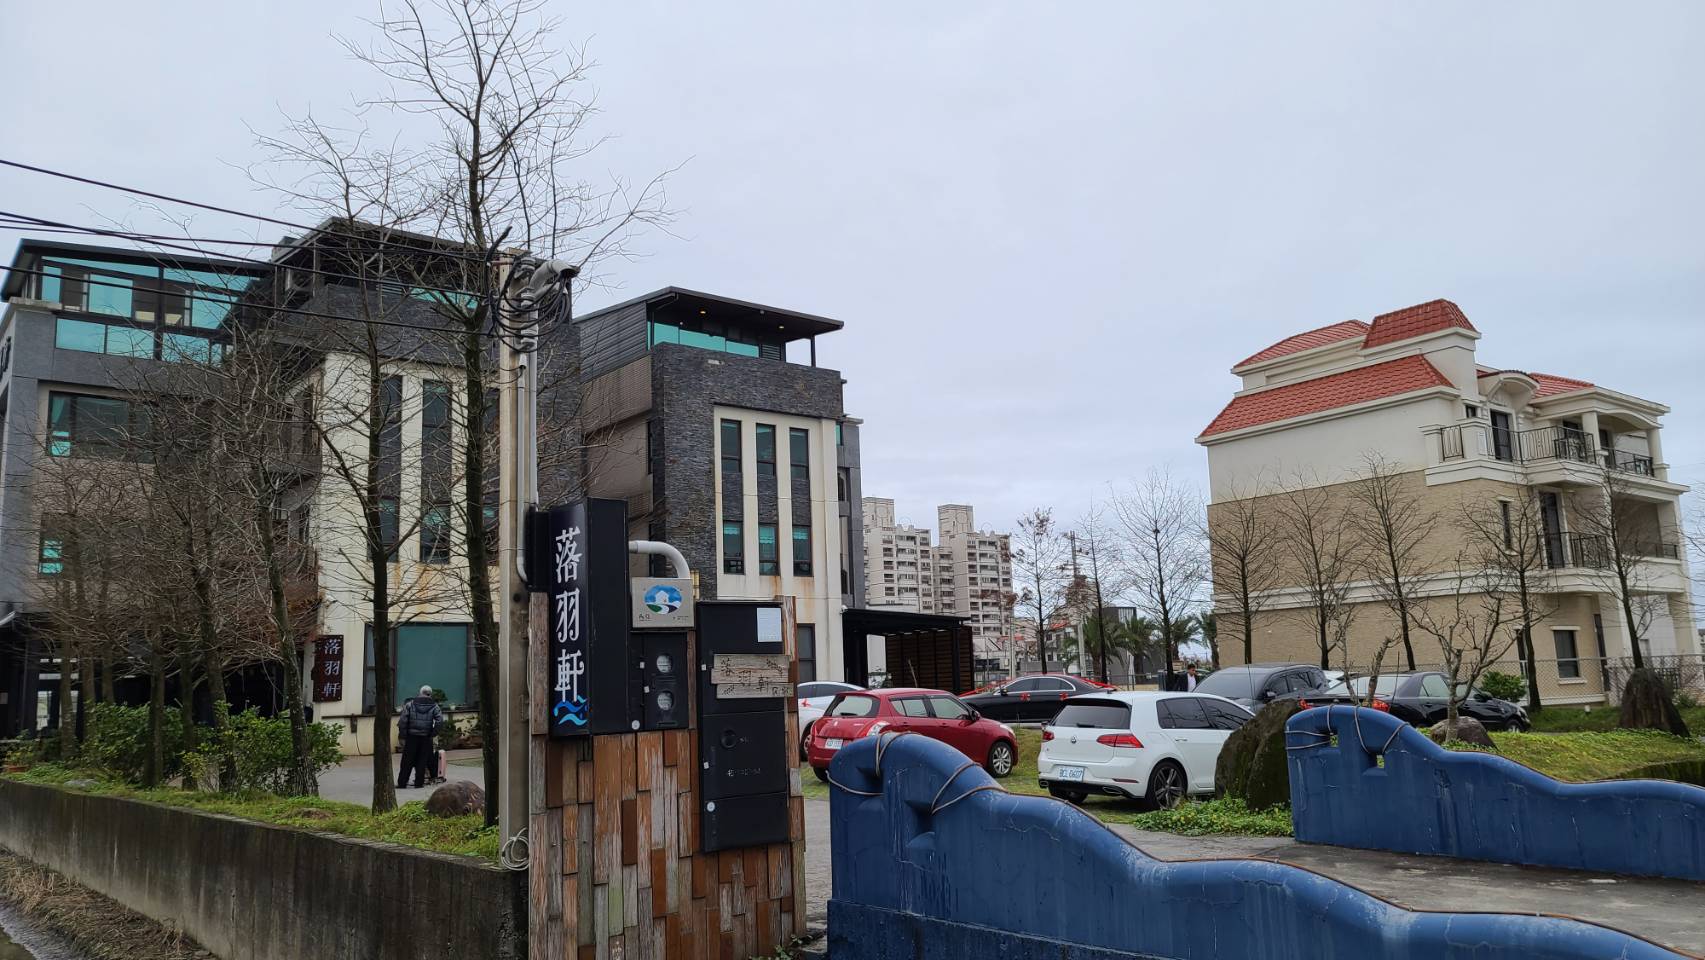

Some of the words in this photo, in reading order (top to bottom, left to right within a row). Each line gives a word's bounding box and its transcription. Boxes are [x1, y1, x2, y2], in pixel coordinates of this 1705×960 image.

[322, 639, 341, 697] 落羽軒
[554, 525, 584, 703] 落羽軒
